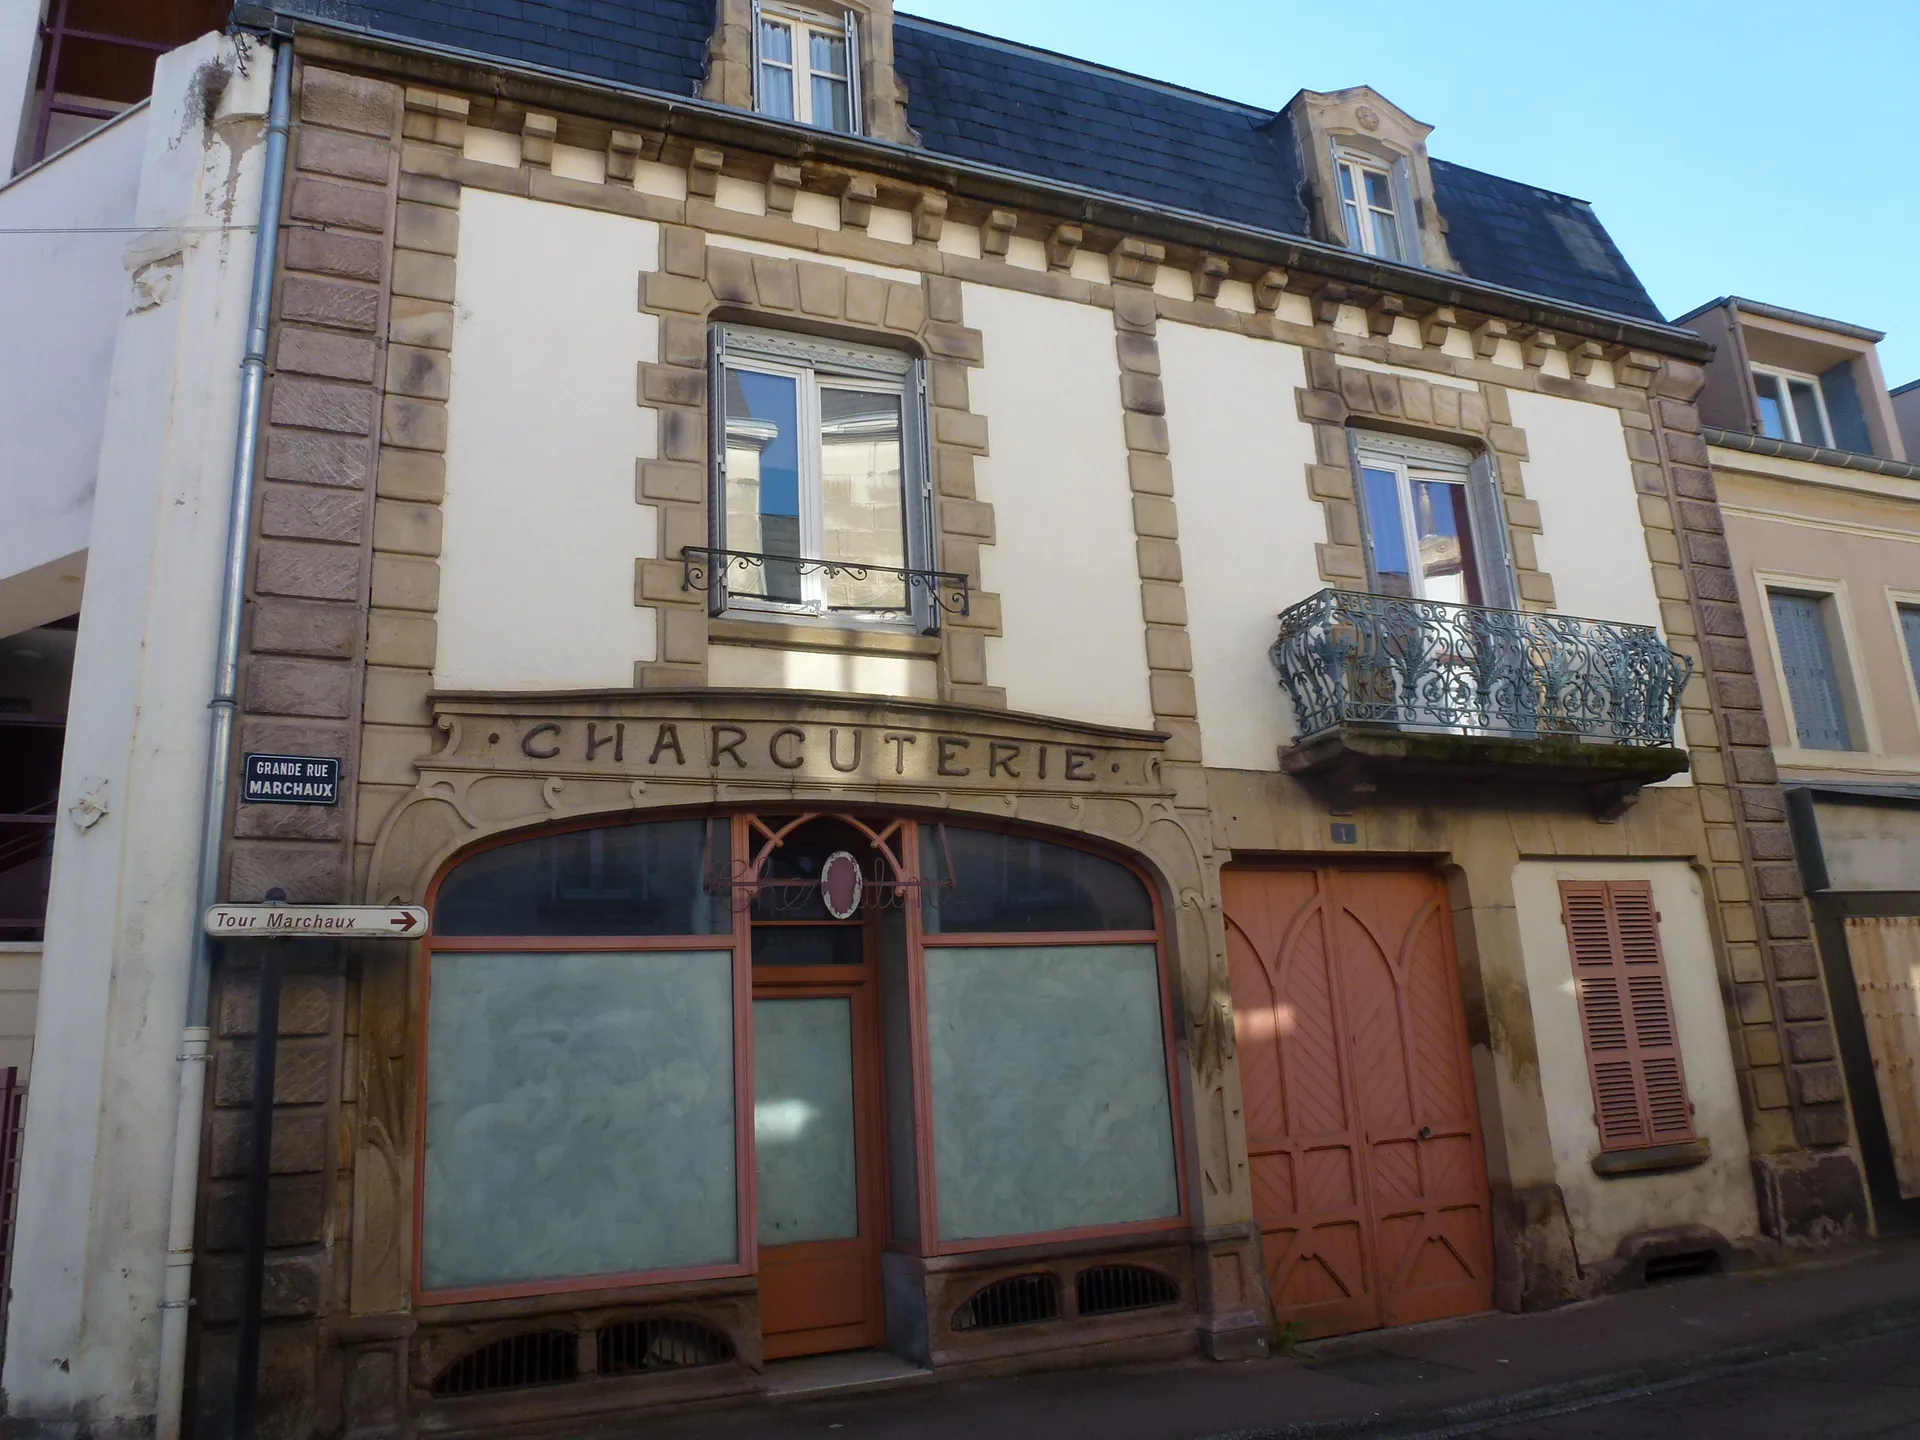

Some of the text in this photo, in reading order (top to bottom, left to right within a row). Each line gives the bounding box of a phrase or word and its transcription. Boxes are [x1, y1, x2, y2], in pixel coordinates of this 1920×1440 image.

[521, 721, 1097, 781] CHARCUTERIE
[256, 761, 329, 778] GRANDE RUE
[249, 780, 333, 798] MARCHAUX
[217, 912, 356, 929] Tour Marchaux
